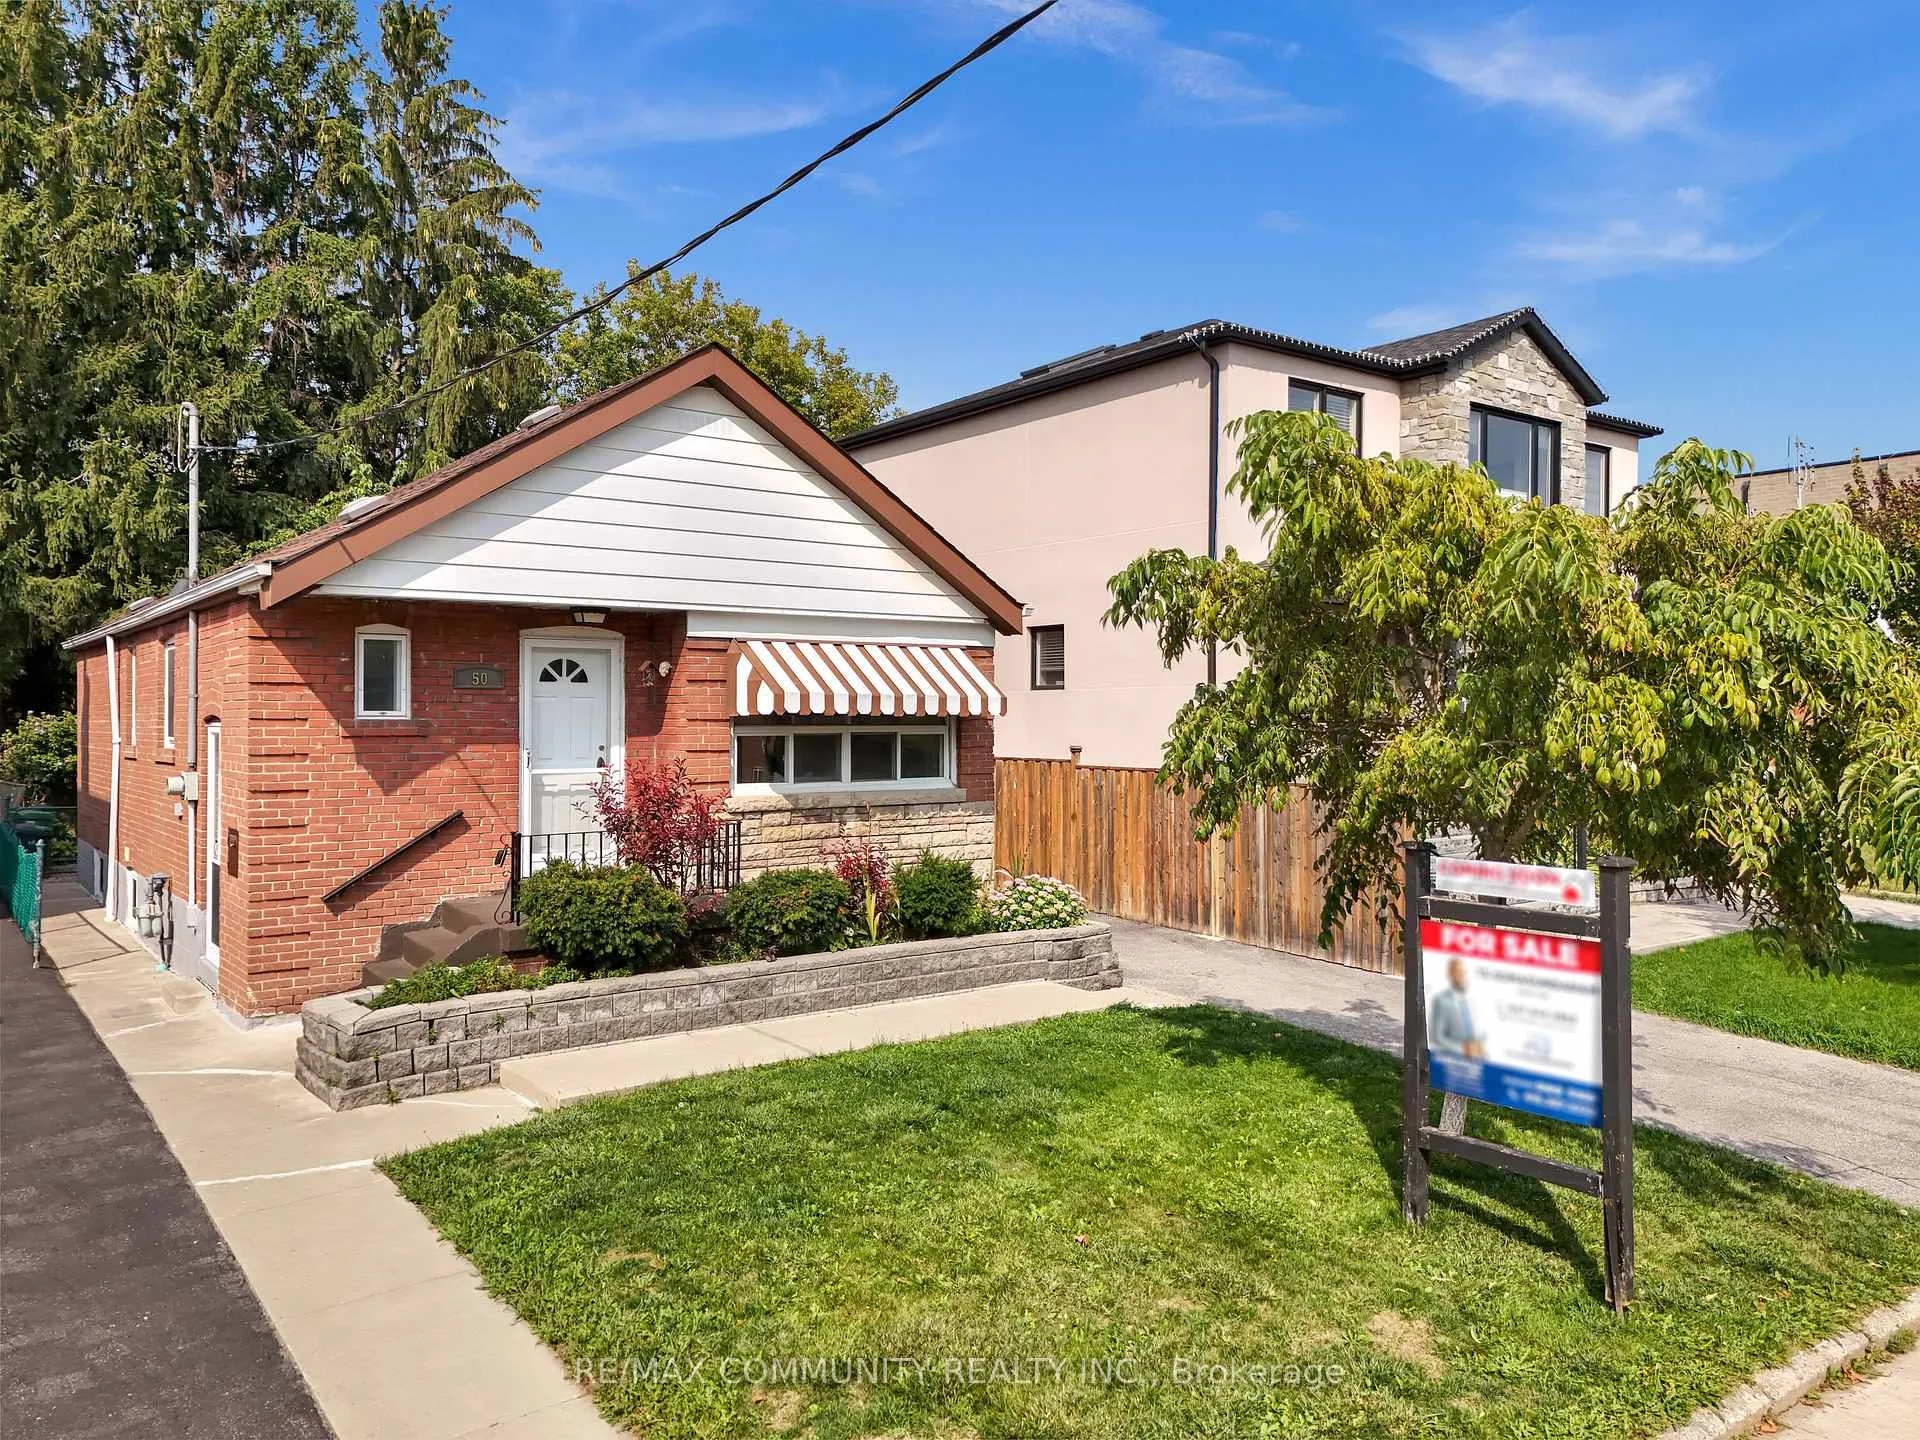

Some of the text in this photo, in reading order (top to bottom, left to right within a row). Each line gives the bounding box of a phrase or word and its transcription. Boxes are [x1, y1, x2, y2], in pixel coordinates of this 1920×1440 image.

[472, 672, 488, 685] 50
[1441, 926, 1579, 966] FOR SALE
